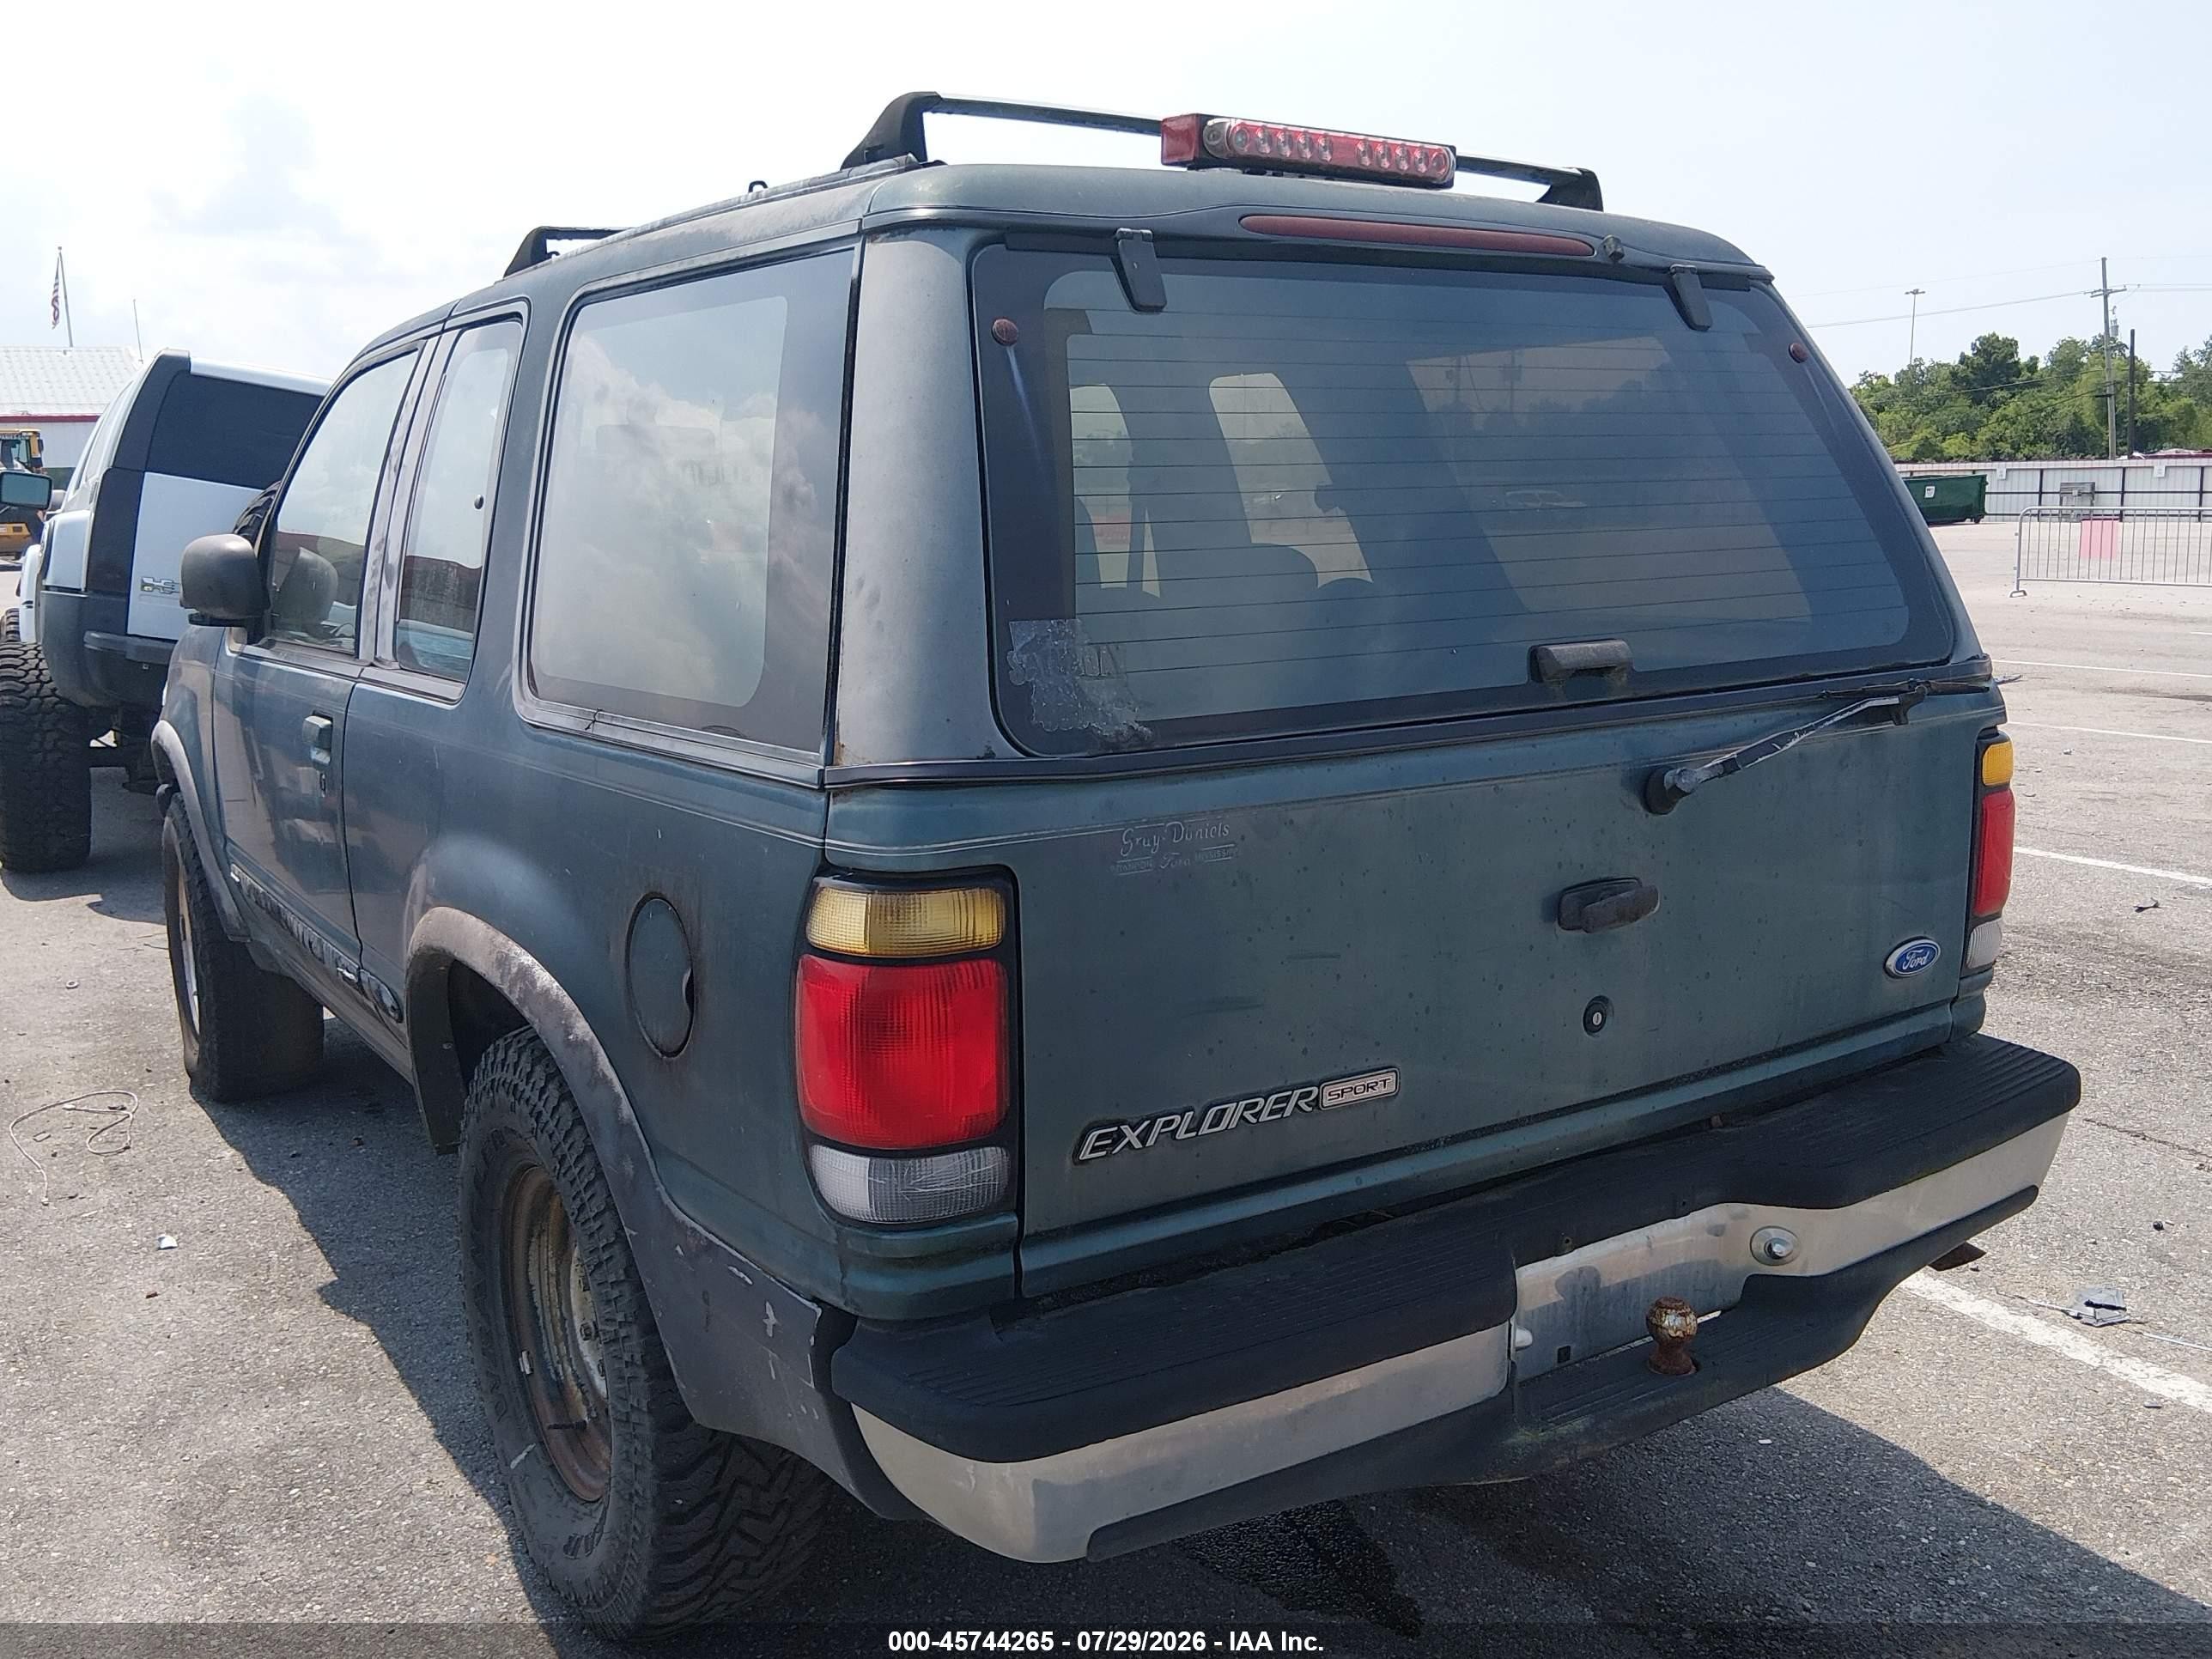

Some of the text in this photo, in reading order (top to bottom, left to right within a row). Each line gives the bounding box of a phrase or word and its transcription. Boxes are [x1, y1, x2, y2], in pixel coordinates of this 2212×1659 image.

[1902, 949, 1930, 970] Ford
[1077, 1077, 1391, 1161] EXPLORER SPORT
